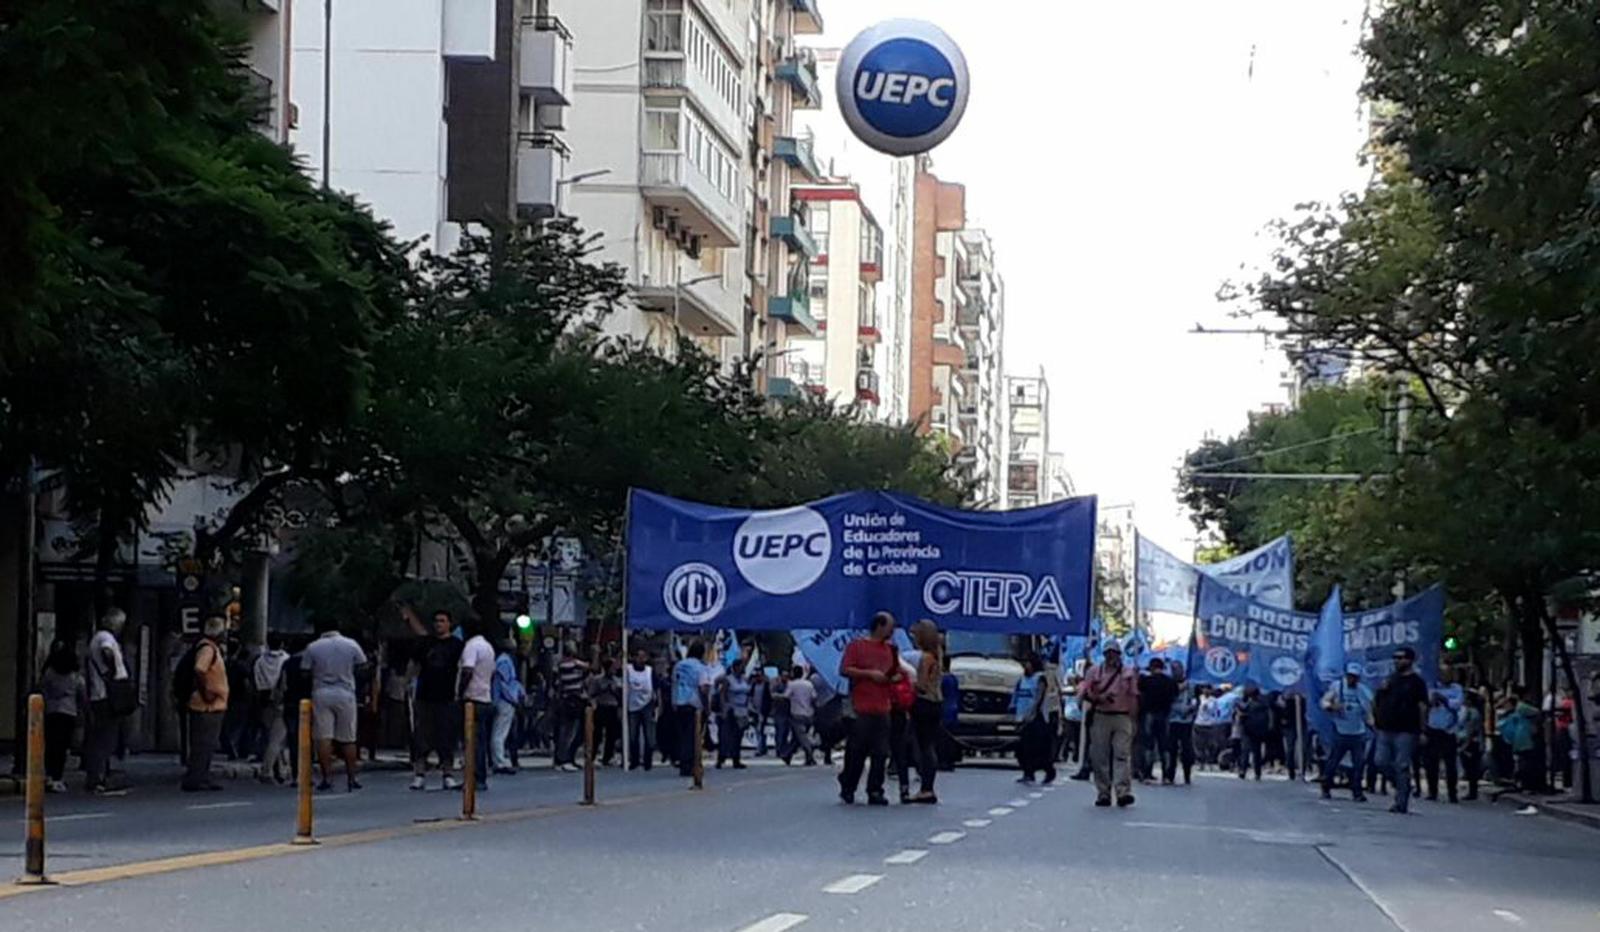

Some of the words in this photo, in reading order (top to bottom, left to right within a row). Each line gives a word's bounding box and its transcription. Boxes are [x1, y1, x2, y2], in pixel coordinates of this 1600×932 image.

[857, 71, 954, 107] UEPC
[889, 513, 905, 526] de
[739, 532, 826, 559] UEPC
[843, 528, 920, 542] Educadores
[843, 545, 863, 559] de
[867, 545, 880, 558] la
[882, 545, 940, 559] Provincia
[843, 561, 864, 575] de
[675, 573, 715, 613] CGT
[923, 570, 1071, 620] CTERA
[182, 607, 200, 633] E
[1210, 613, 1309, 650] COLEGIOS
[1248, 605, 1356, 632] DOCENS
